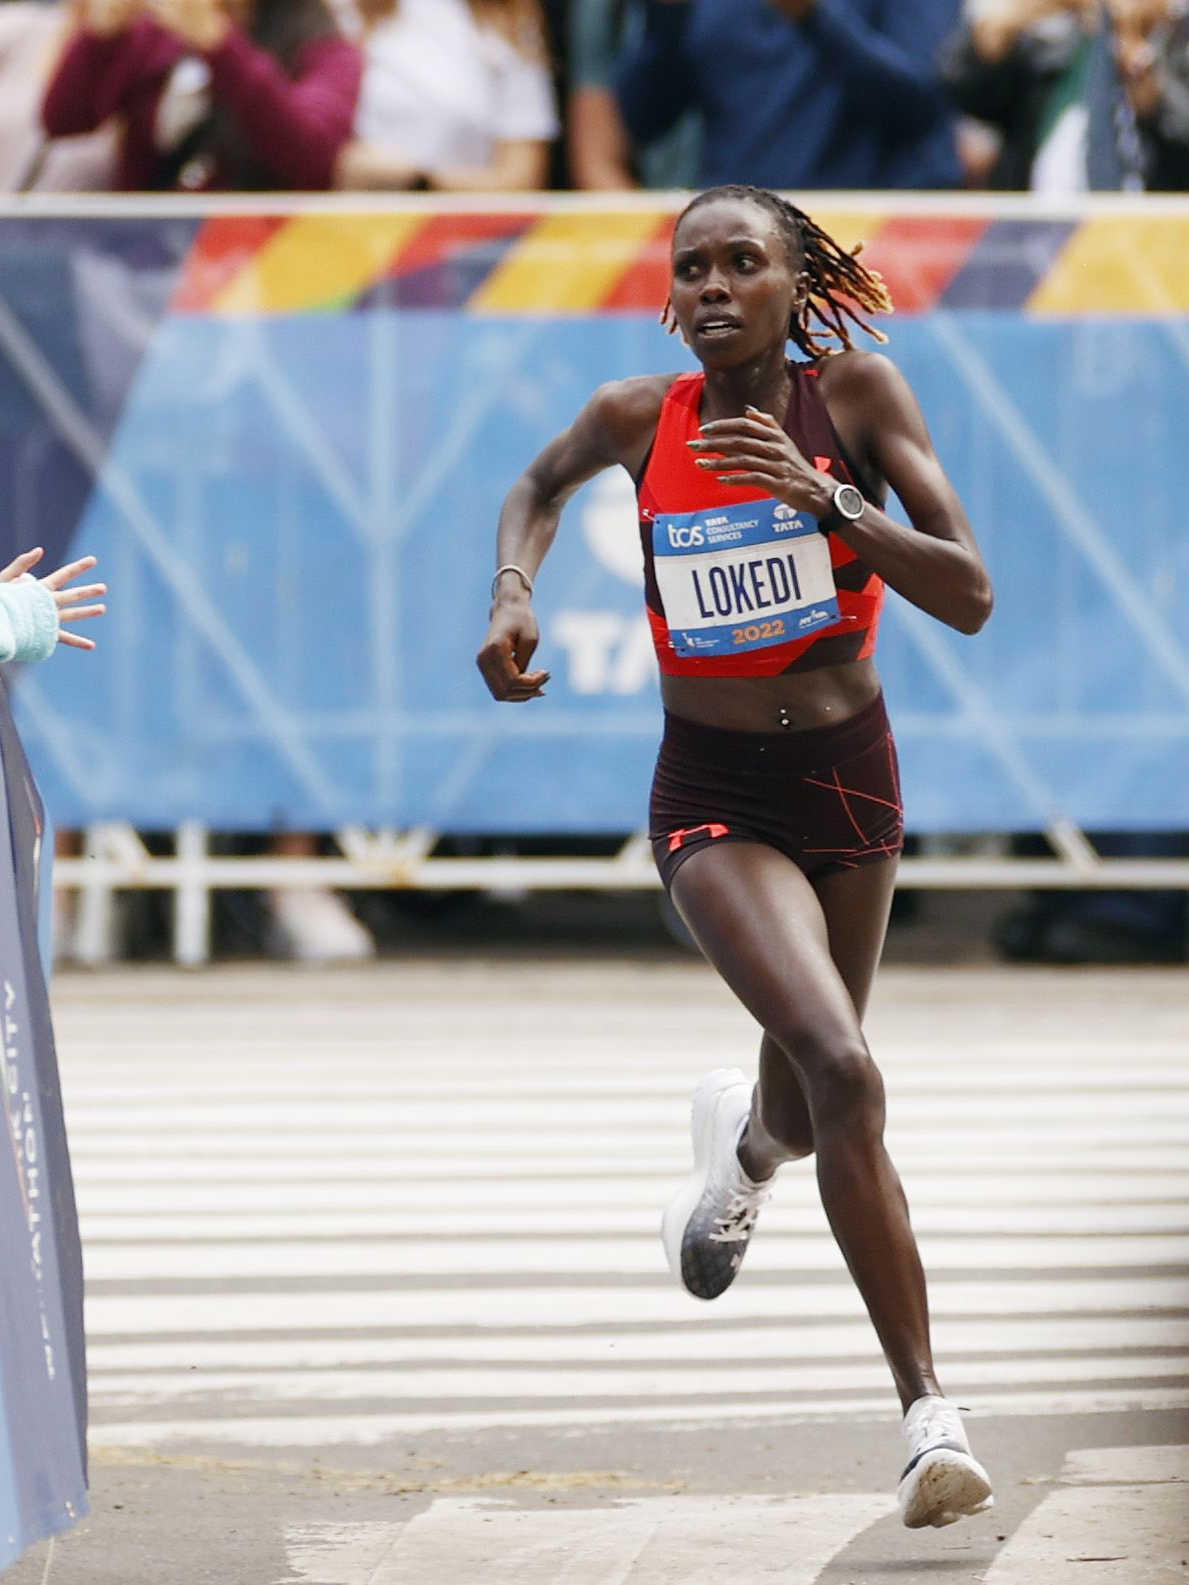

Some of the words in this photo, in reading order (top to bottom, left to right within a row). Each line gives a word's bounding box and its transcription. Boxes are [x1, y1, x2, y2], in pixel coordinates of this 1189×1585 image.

[704, 516, 729, 527] TATA
[705, 519, 760, 535] CONSULTANCY
[771, 520, 804, 533] TATA
[667, 524, 705, 548] tcs
[707, 531, 743, 544] SERVICES
[691, 553, 802, 619] LOKEDI
[731, 619, 787, 645] 2022
